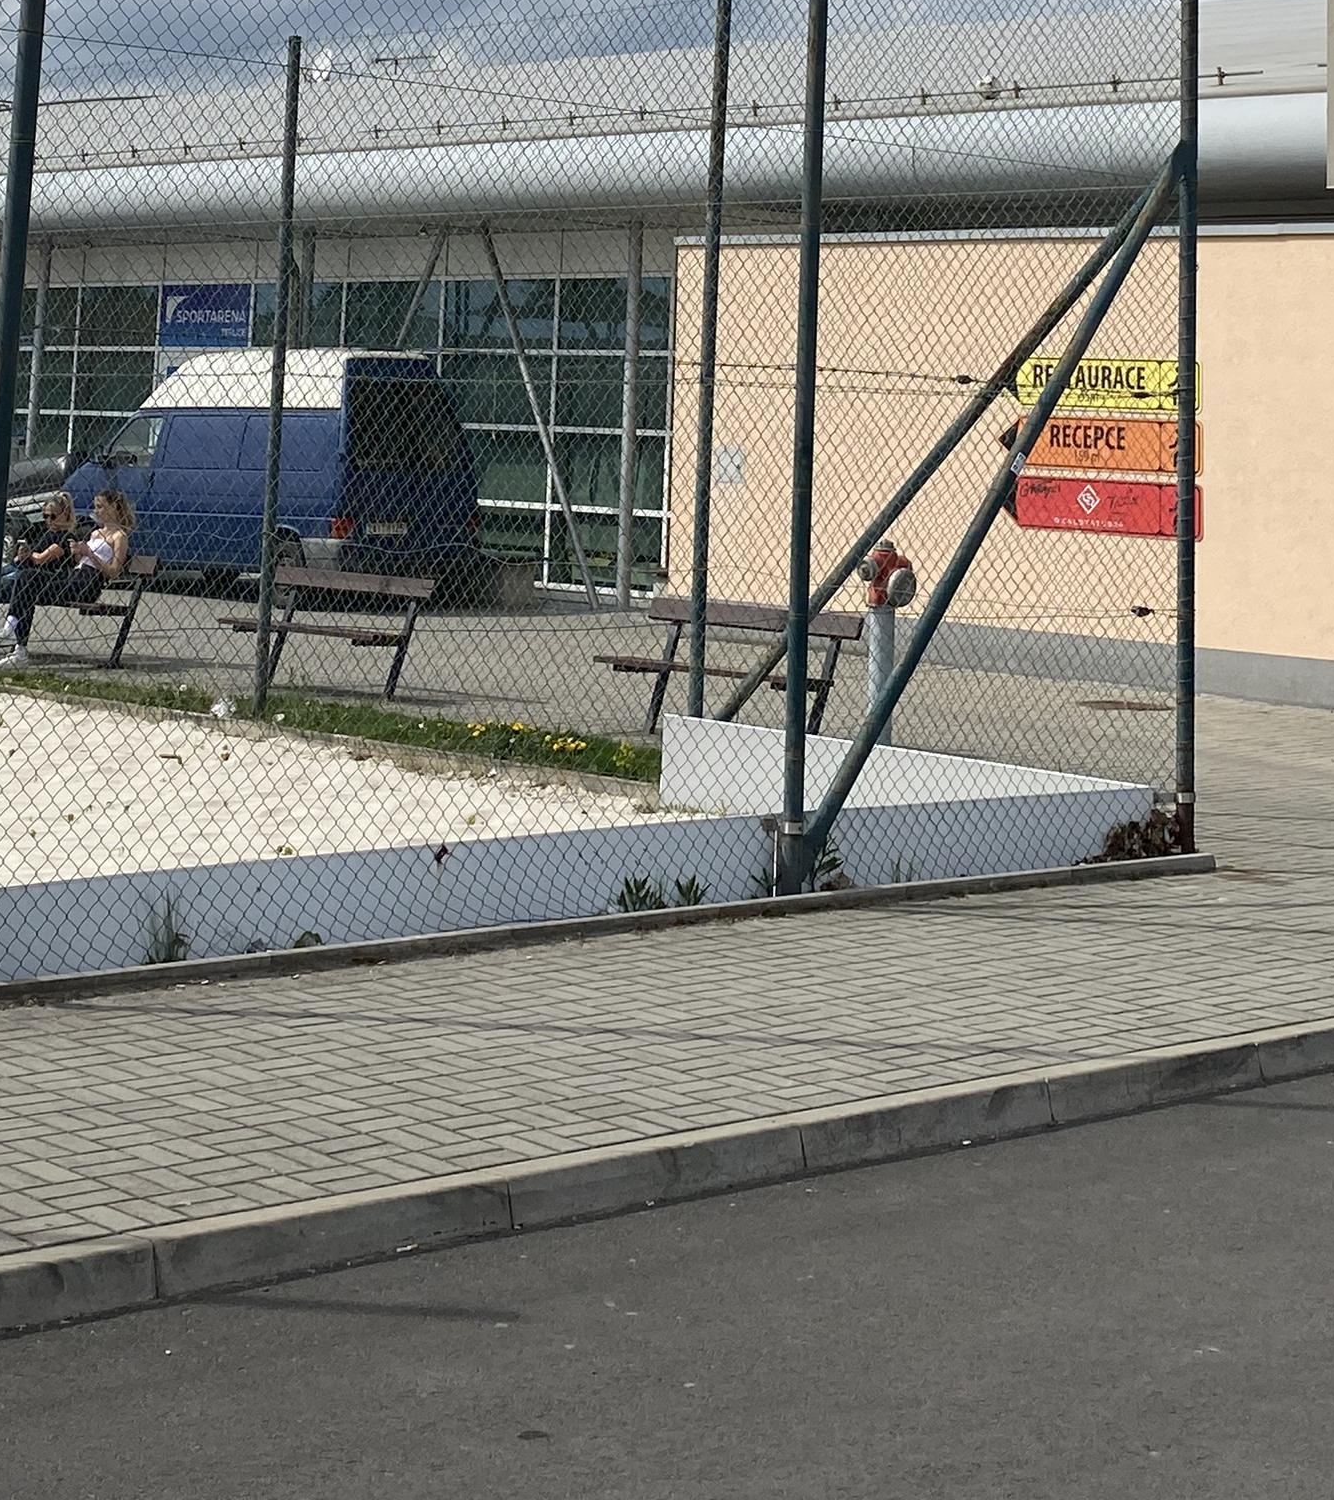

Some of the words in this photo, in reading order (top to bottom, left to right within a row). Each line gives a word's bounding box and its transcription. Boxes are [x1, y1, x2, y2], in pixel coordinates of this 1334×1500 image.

[175, 309, 246, 324] SPORTARENA
[1032, 363, 1146, 391] REAURACE
[1049, 424, 1126, 451] RECEPCE
